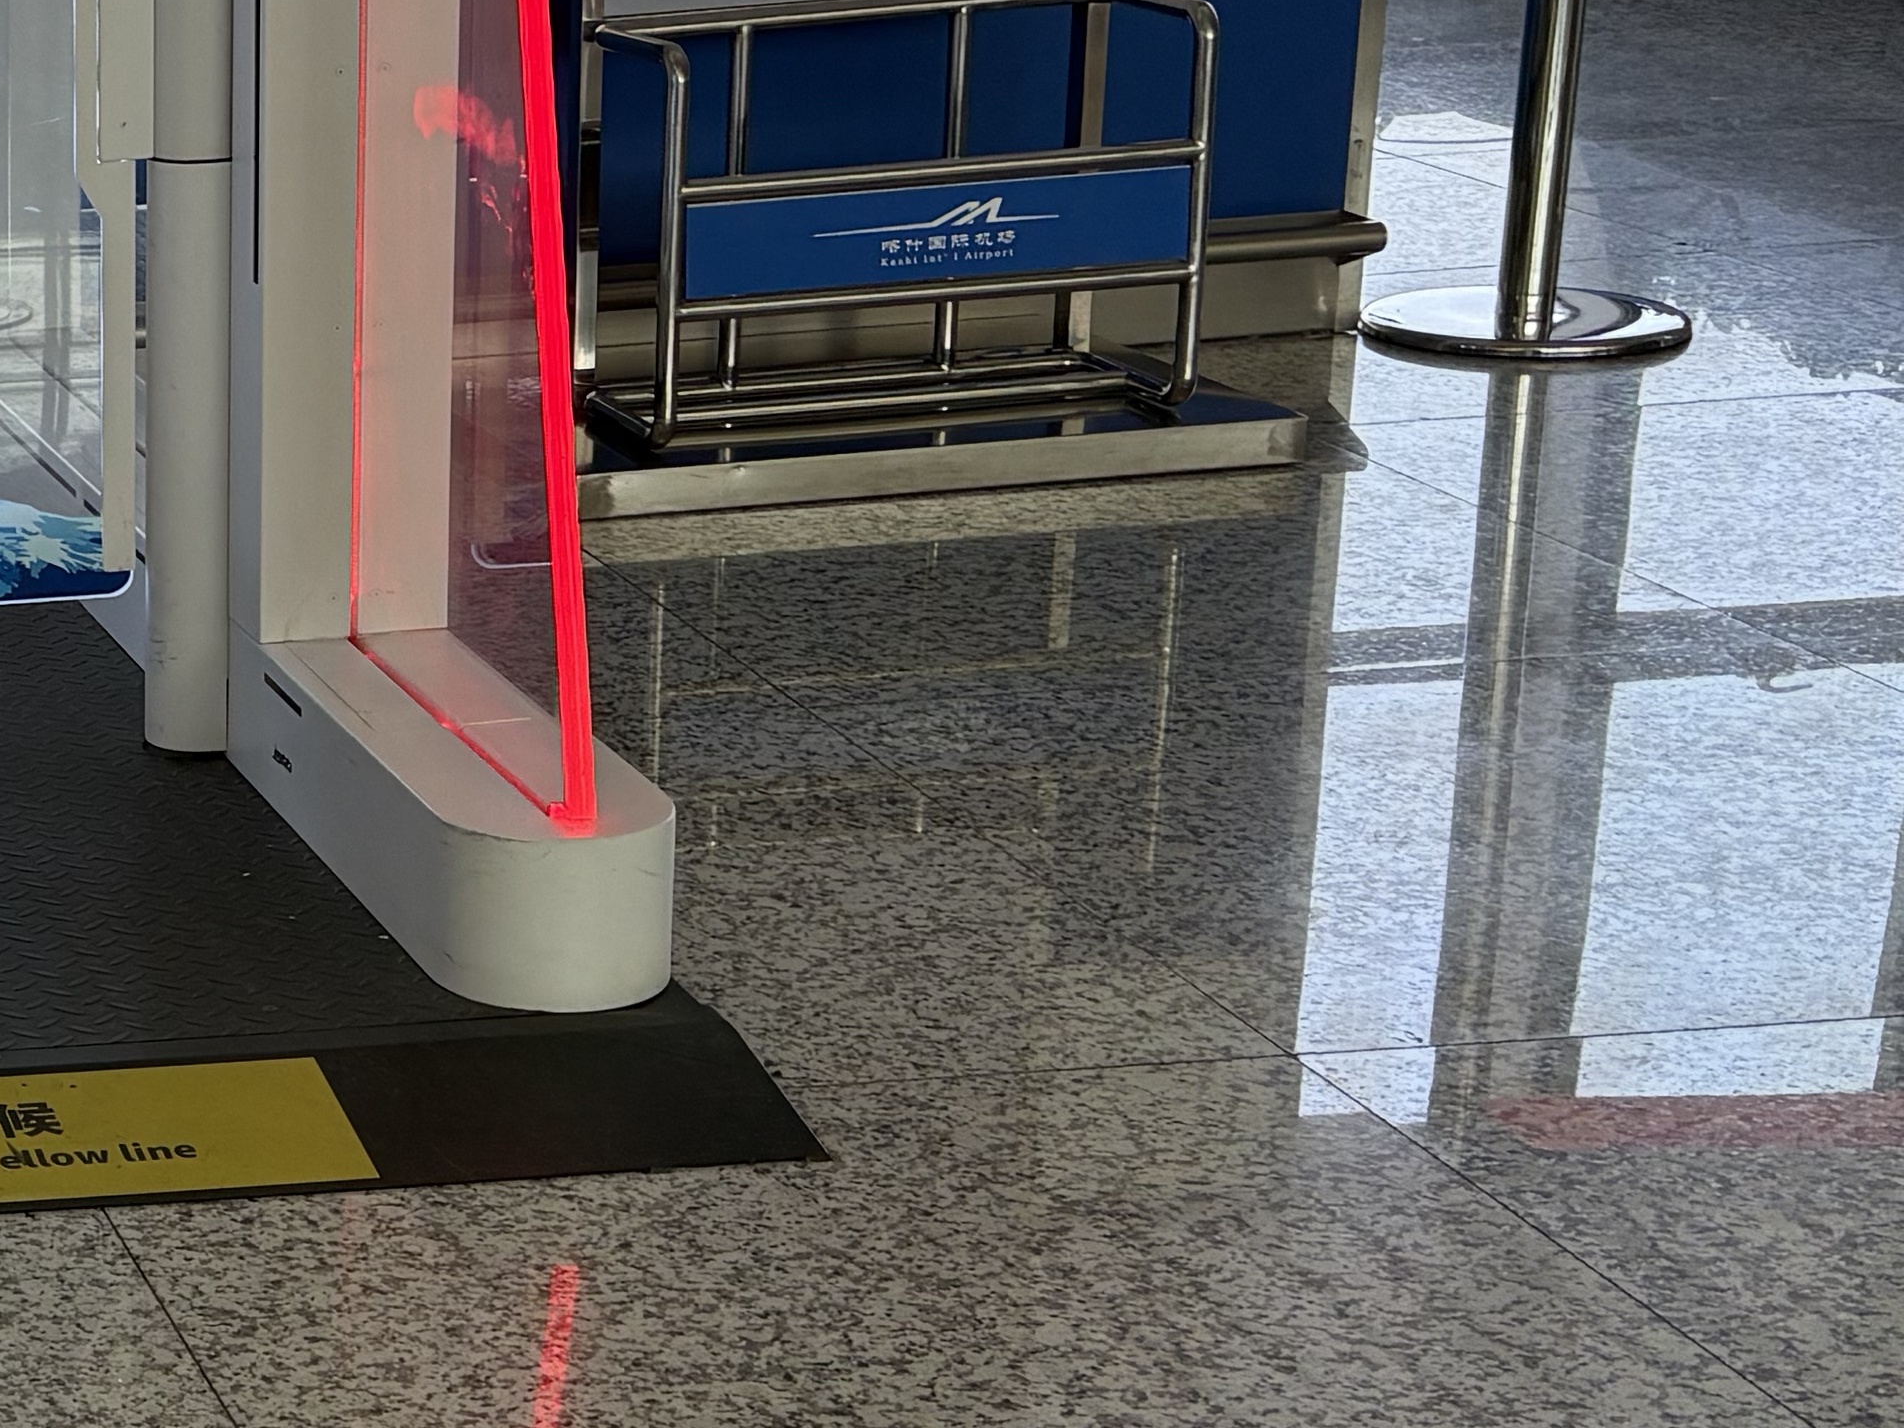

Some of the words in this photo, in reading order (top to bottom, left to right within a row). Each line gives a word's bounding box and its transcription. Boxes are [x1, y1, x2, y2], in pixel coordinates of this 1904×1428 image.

[880, 229, 1016, 254] 喀什国际机场
[880, 255, 918, 267] Kashi
[964, 249, 1014, 261] Airport
[118, 1139, 198, 1166] line
